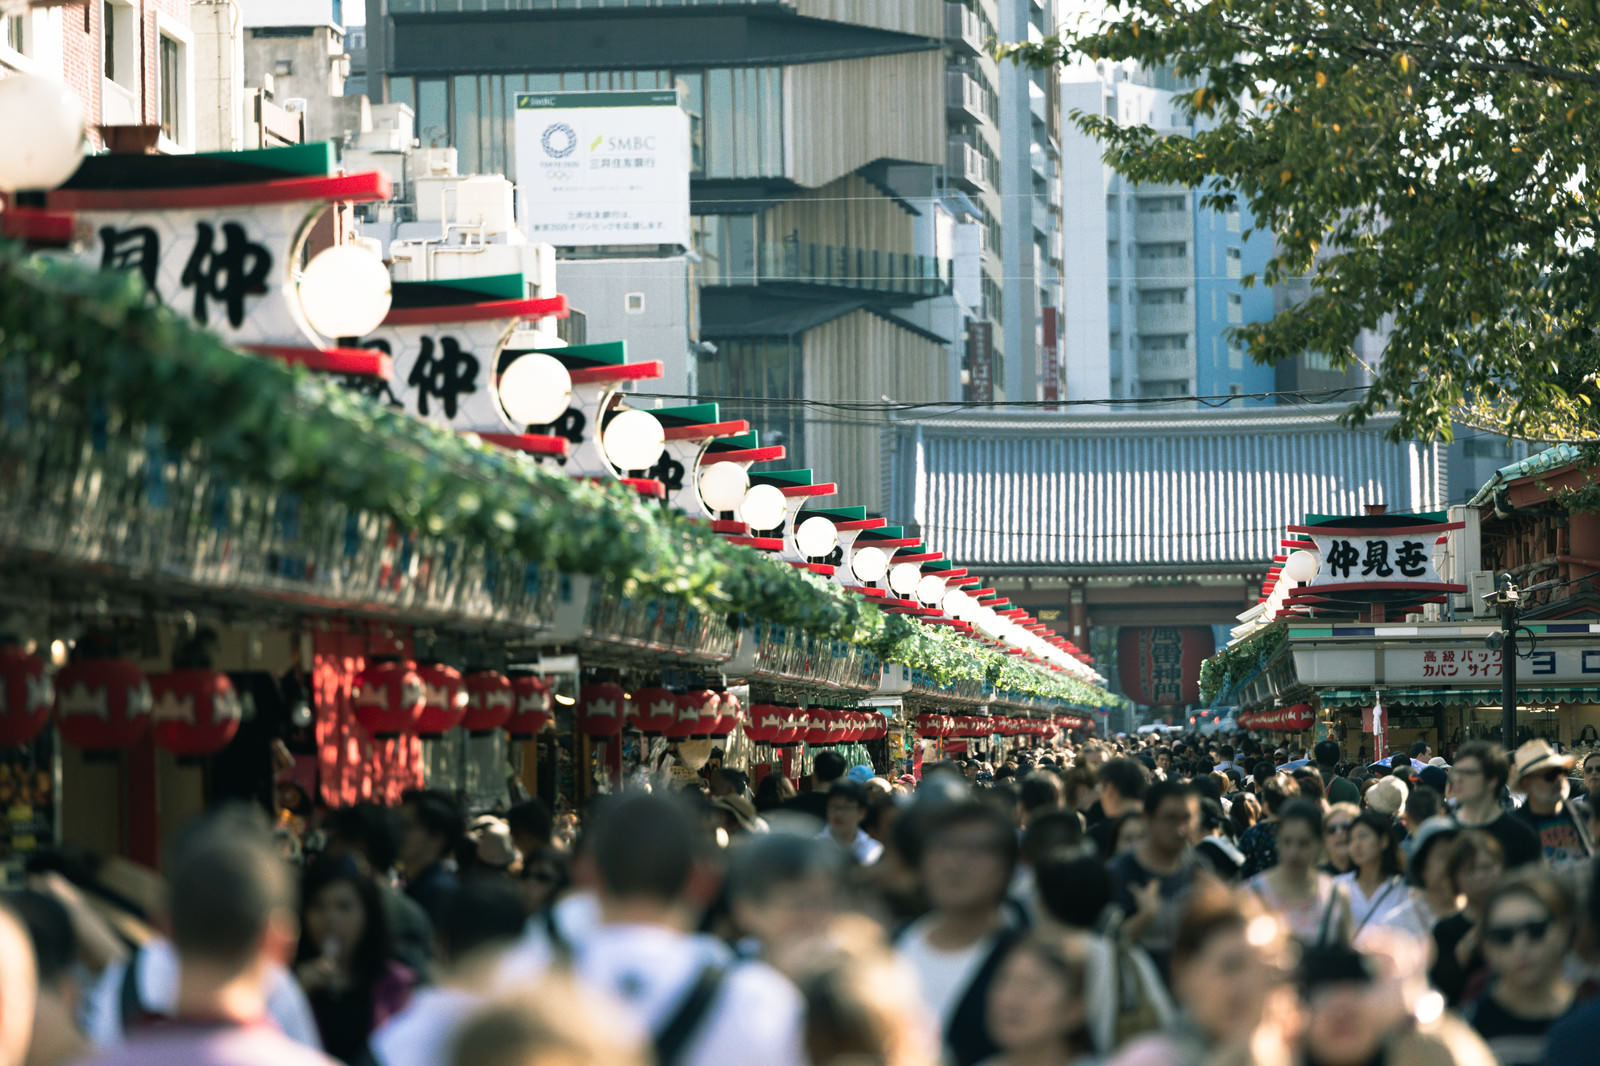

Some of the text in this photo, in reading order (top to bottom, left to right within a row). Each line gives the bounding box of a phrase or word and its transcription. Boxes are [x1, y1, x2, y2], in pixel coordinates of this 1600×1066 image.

[608, 136, 656, 151] SMBC
[1423, 664, 1459, 677] カバン
